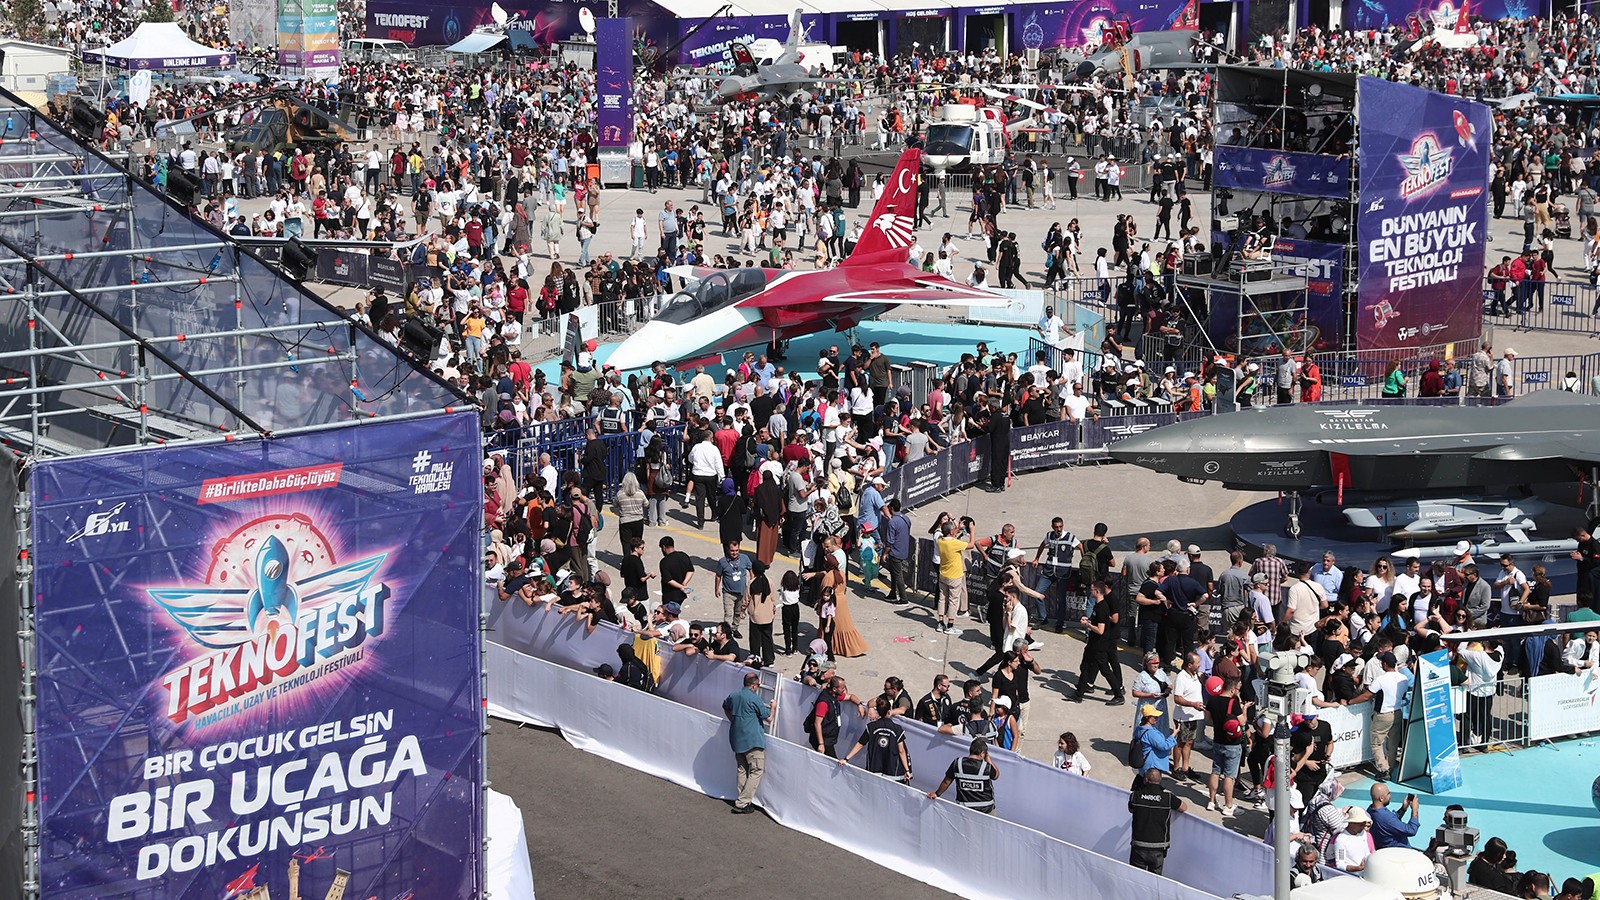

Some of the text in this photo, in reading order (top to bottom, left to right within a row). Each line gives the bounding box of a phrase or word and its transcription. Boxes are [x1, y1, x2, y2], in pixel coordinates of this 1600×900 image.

[374, 13, 429, 29] TEKNOFEST
[1401, 157, 1452, 199] TEKNOFEST
[1381, 205, 1467, 237] DÜNYANIN
[1370, 222, 1478, 263] EN BÜYÜK
[1385, 248, 1463, 277] TEKNOLOJİ
[1390, 265, 1458, 293] FESTİVALİ
[1027, 430, 1060, 441] BAYKAR
[205, 470, 337, 498] #BirlikteDahaGüçlüyüz
[408, 471, 452, 486] TEKNOLOJİ
[414, 481, 451, 494] HAMLESİ
[163, 582, 391, 724] TEKNOFEST
[195, 647, 364, 731] HAVACILIK, UZAY VE TEKNOLOJİ FESTİVALİ
[143, 709, 394, 780] BİR ÇOCUK GELSİN
[1332, 728, 1363, 743] KBEY
[106, 734, 428, 843] BİR UÇAĞA
[136, 792, 394, 881] DOKUNSUN
